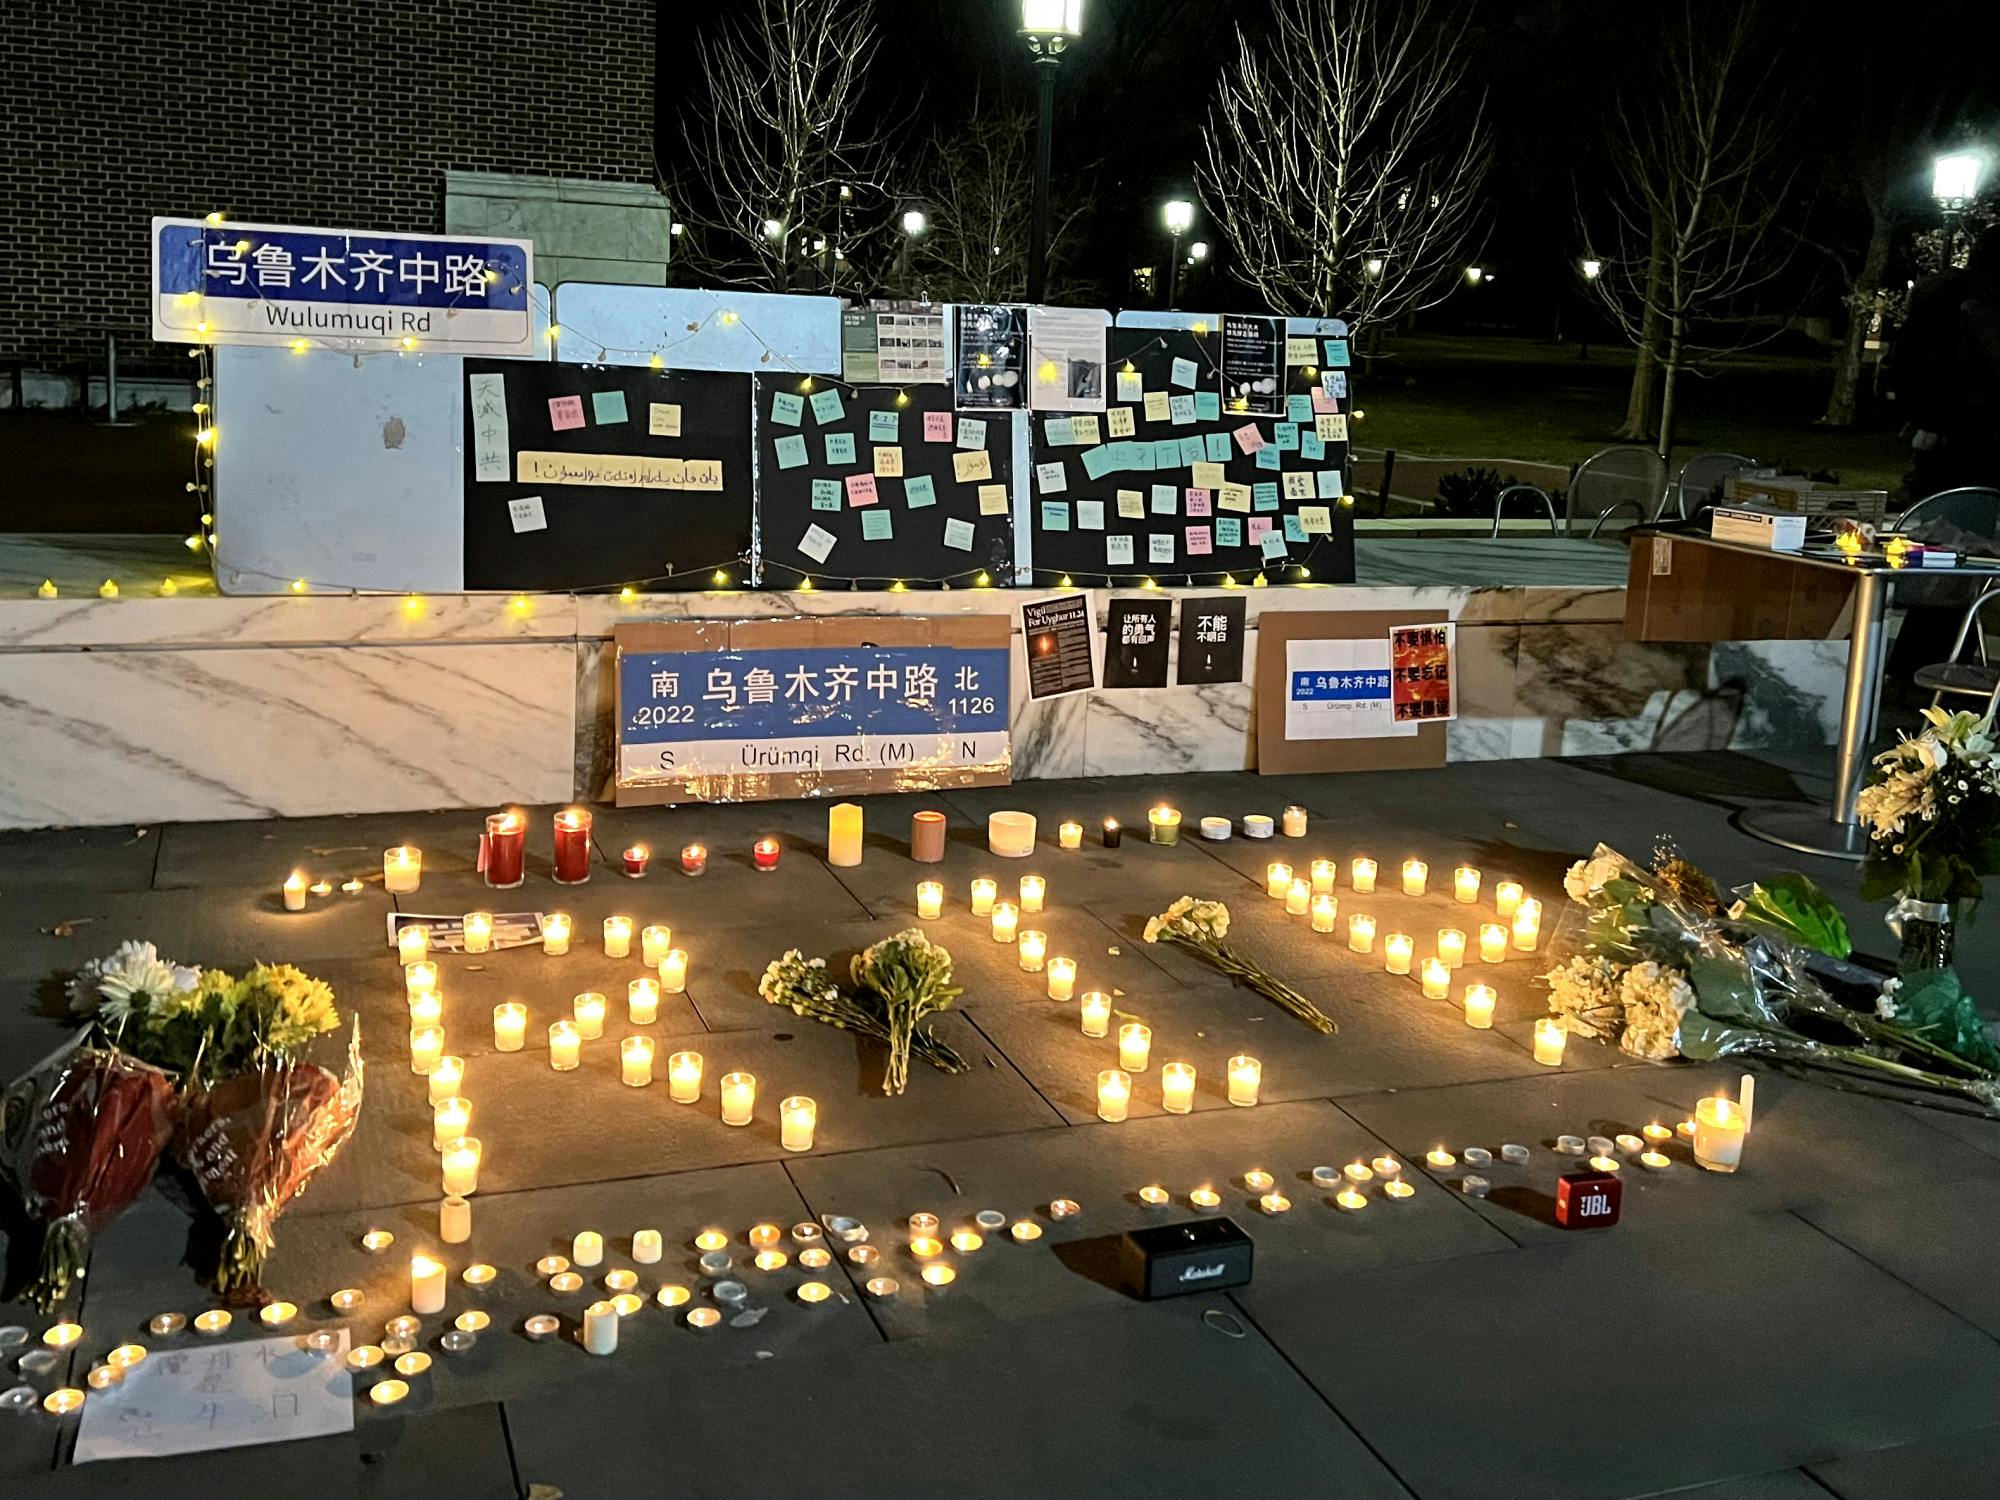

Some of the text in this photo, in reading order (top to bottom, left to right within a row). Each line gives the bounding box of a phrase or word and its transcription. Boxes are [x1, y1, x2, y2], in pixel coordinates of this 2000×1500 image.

[206, 241, 487, 299] 乌鲁木齐中路
[266, 306, 430, 334] Wulumuqi Rd
[1026, 605, 1046, 618] Vigil
[1028, 610, 1085, 627] For Uyghur 11.24
[1123, 614, 1156, 624] 让所有人
[1122, 623, 1156, 636] 的勇气
[1198, 615, 1228, 632] 不能
[1196, 631, 1227, 643] 不明白
[1393, 630, 1446, 647] 不要惧怕
[1315, 675, 1390, 690] 乌鲁木齐中路
[1395, 666, 1448, 682] 不要忘记
[650, 662, 979, 706] 南 乌鲁木齐中路 北
[1296, 688, 1314, 696] 2022
[639, 697, 995, 726] 2022 1126
[1302, 703, 1308, 711] S
[659, 750, 675, 770] S
[741, 743, 819, 772] Ürümqi
[879, 741, 915, 766] (M)
[961, 741, 977, 760] N
[1580, 1194, 1612, 1217] JBL
